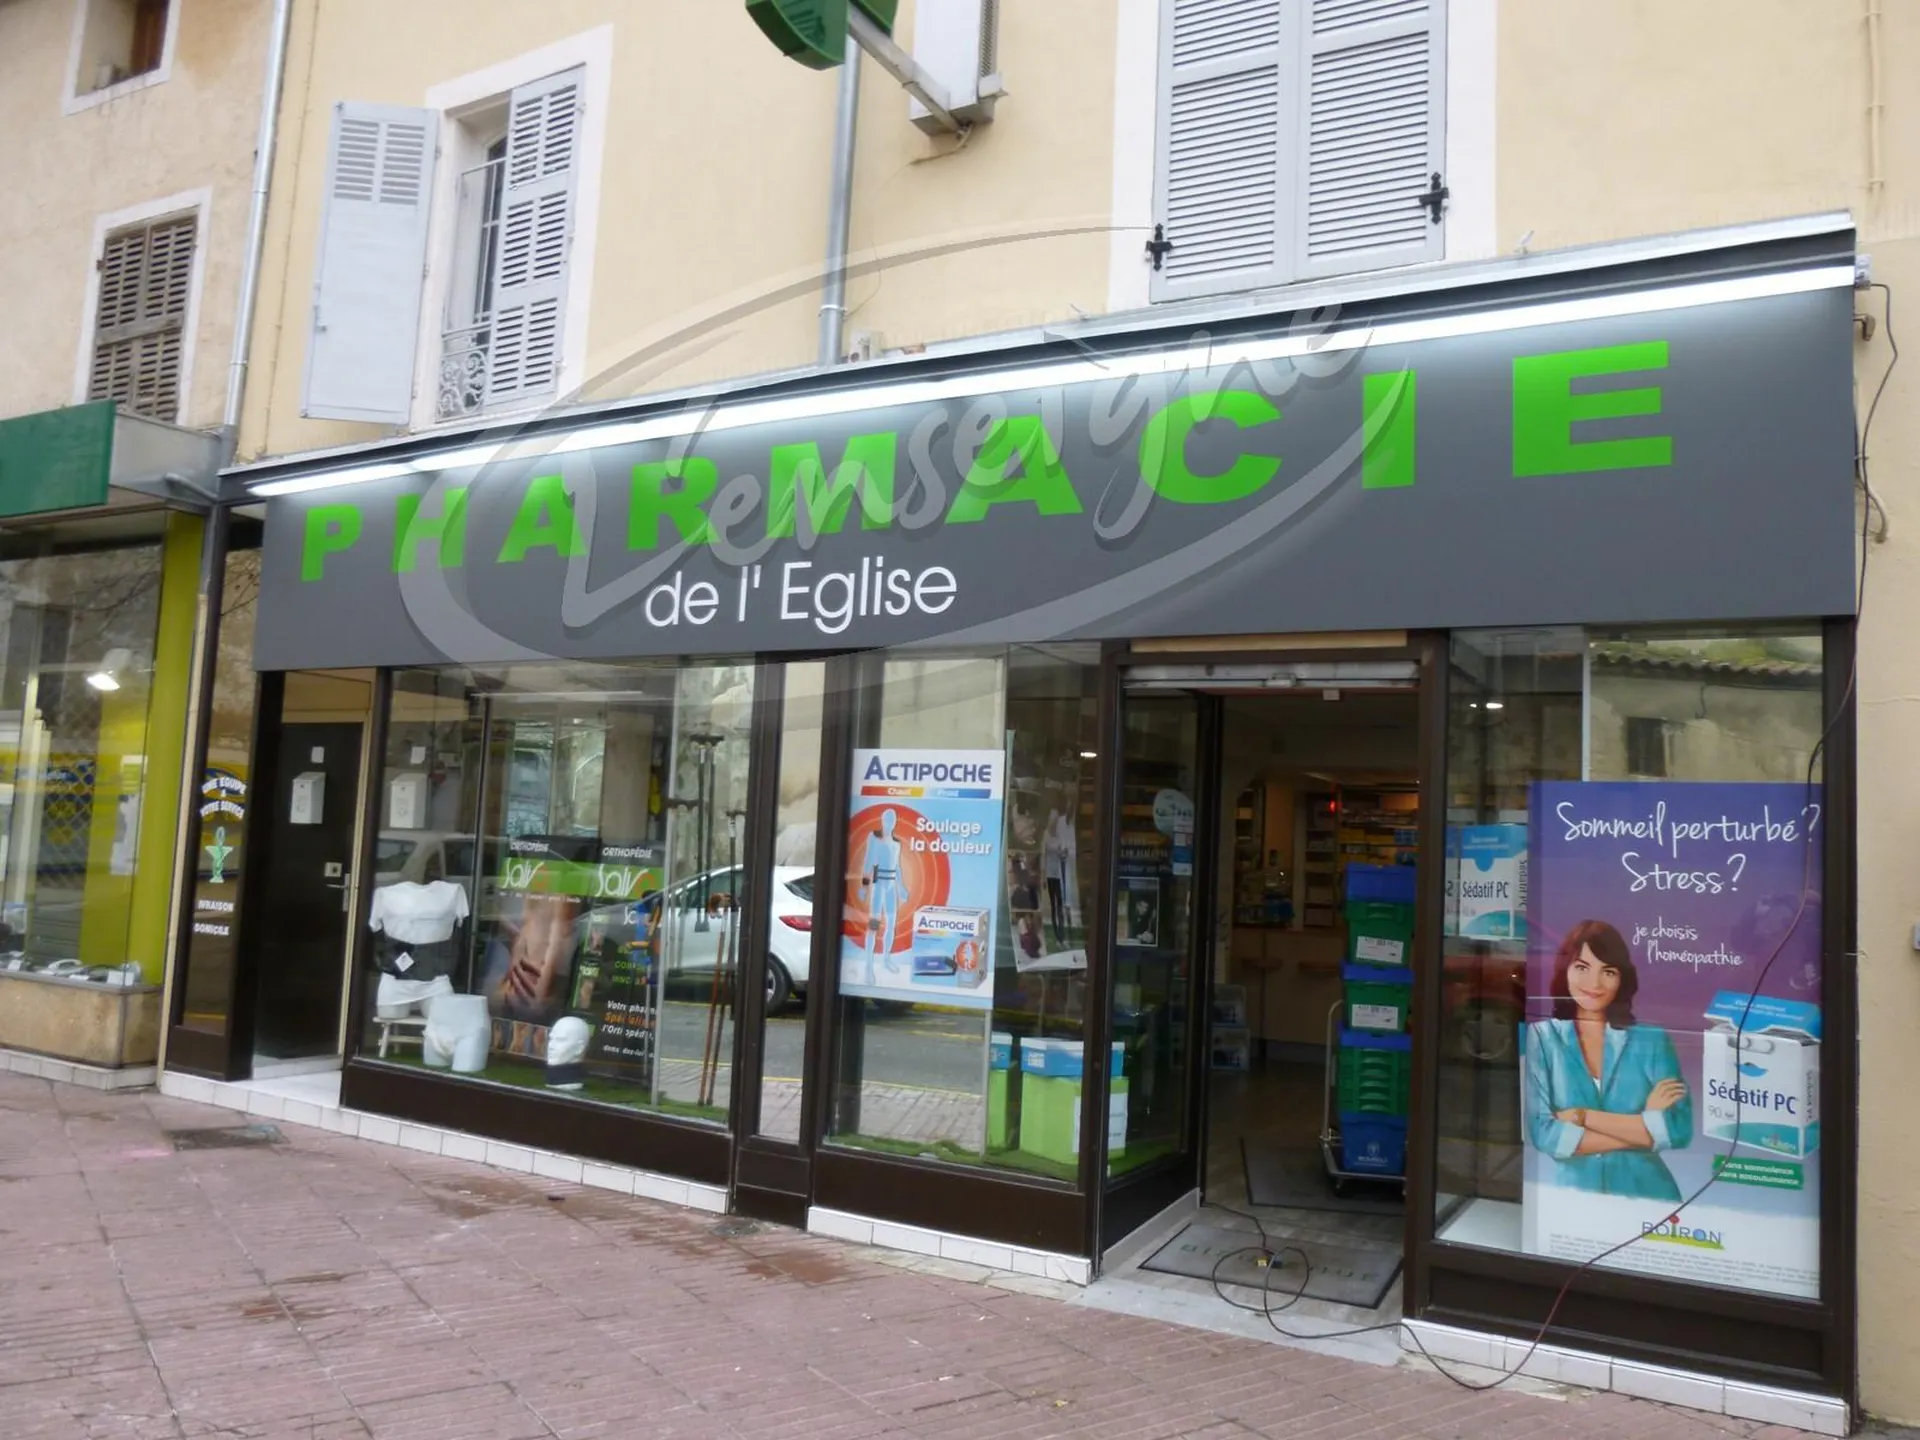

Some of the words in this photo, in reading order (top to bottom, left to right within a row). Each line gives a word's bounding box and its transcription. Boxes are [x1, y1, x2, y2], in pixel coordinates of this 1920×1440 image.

[302, 341, 1673, 582] PHARMACIE
[644, 570, 720, 627] de
[780, 556, 957, 634] Eglise
[864, 755, 992, 783] ACTIPOCHE
[916, 817, 981, 837] Soulage
[1556, 800, 1666, 846] Sommeil
[910, 837, 925, 852] la
[930, 837, 991, 855] douleur
[1496, 882, 1509, 898] PC
[918, 915, 975, 931] ACTIPOCHE
[1633, 922, 1648, 946] je
[1651, 916, 1698, 942] choisis
[1647, 940, 1744, 973] l'homéopathie
[1708, 1078, 1769, 1109] Sédatif
[1774, 1092, 1797, 1115] PC
[1641, 1215, 1723, 1245] BOIRON
